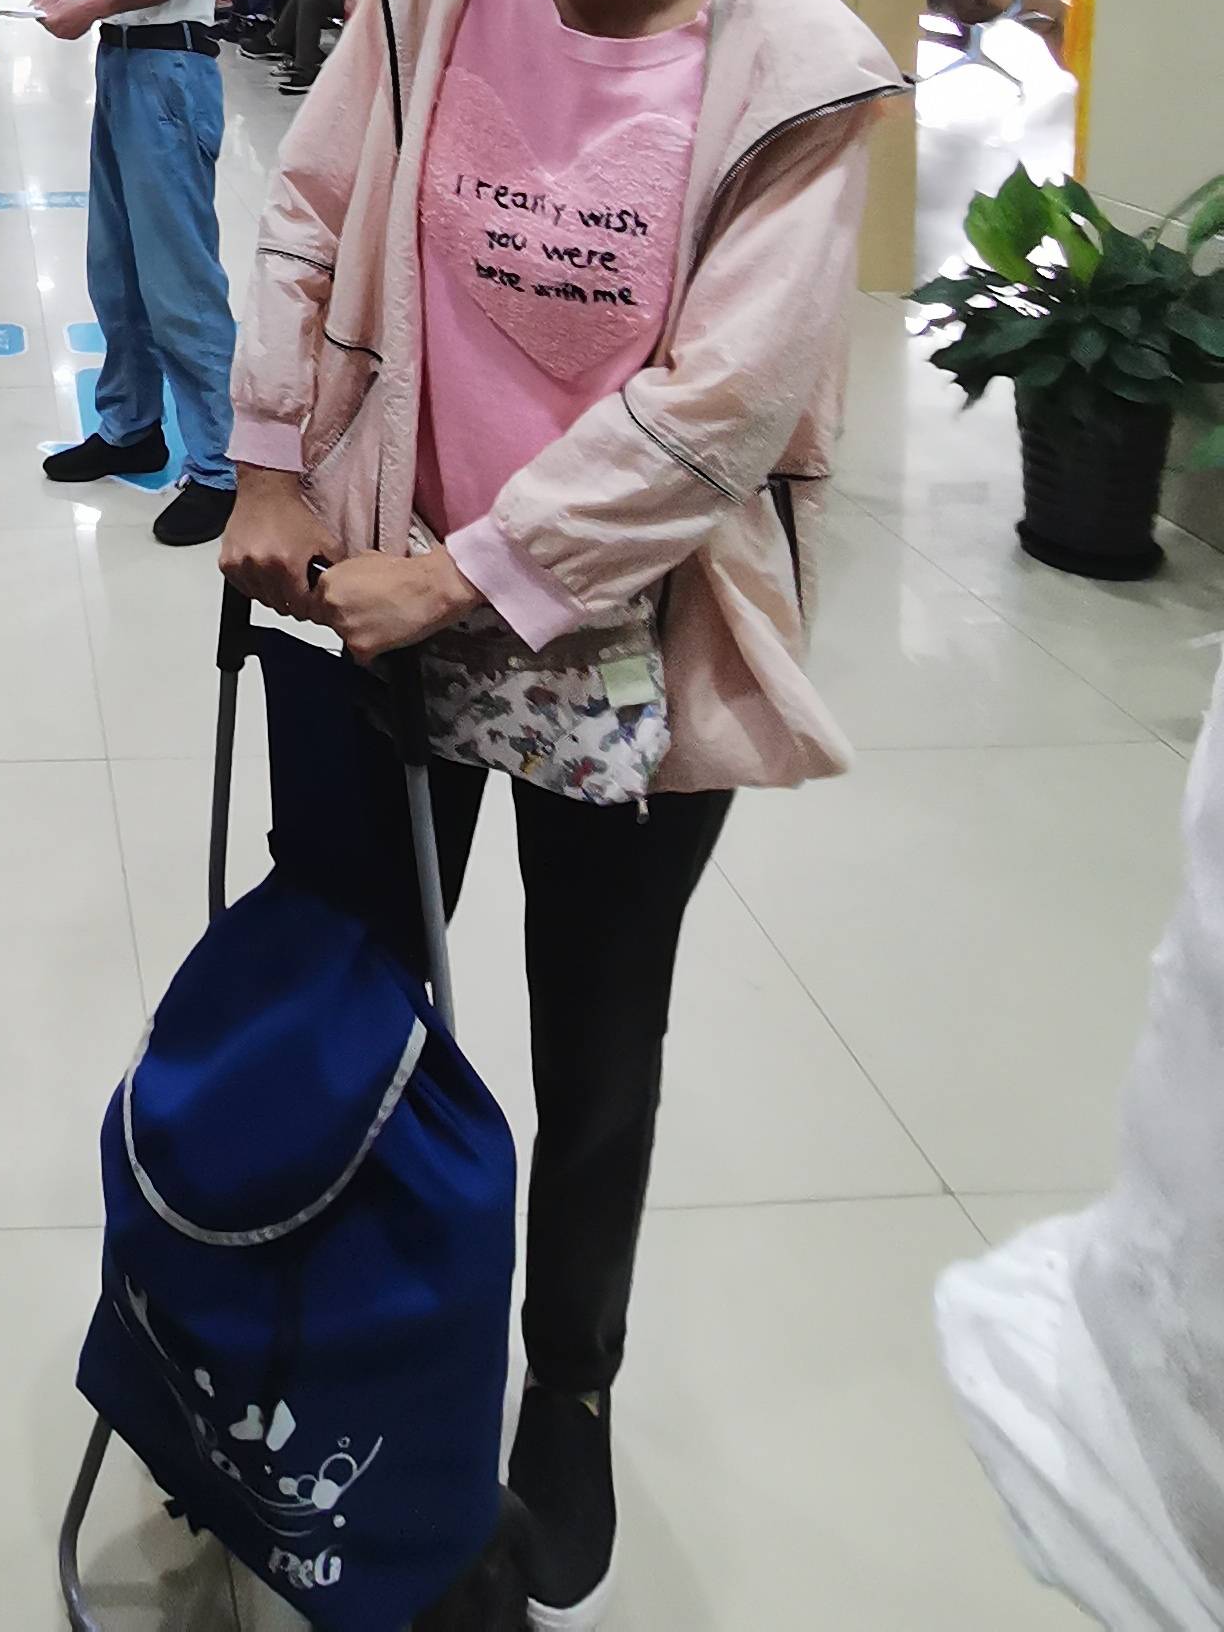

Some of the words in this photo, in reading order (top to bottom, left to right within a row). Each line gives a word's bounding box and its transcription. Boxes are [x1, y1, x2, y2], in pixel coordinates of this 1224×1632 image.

[455, 174, 465, 196] I
[476, 177, 567, 226] really
[576, 206, 649, 237] wish
[542, 242, 619, 274] were
[531, 280, 587, 305] with
[592, 287, 640, 307] me
